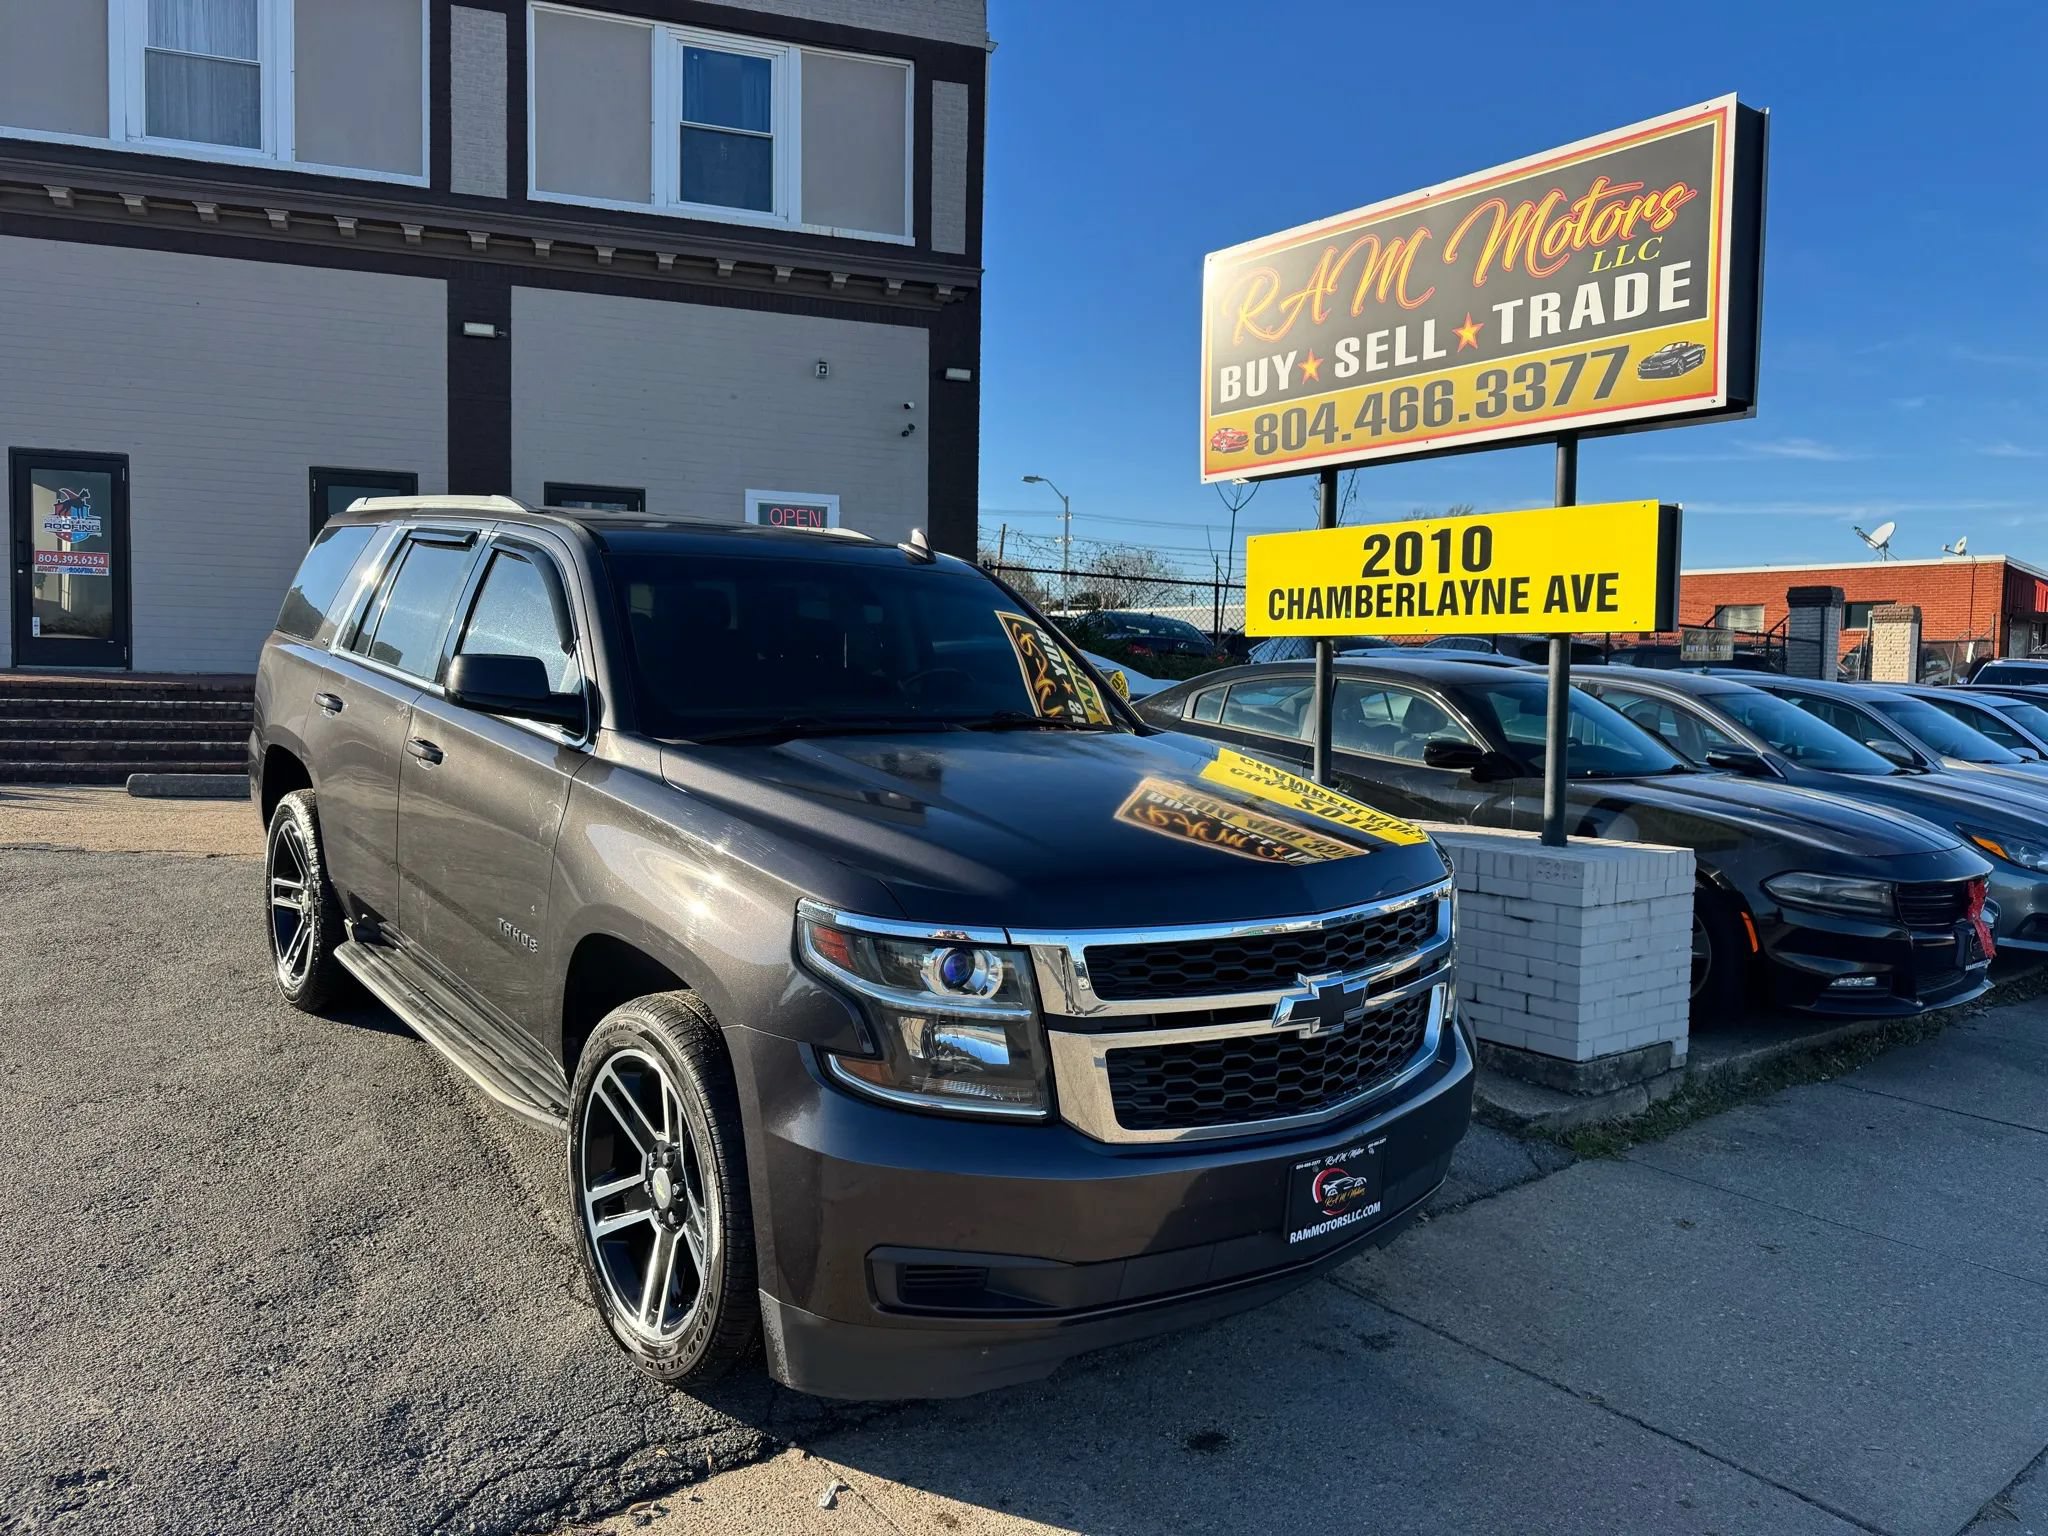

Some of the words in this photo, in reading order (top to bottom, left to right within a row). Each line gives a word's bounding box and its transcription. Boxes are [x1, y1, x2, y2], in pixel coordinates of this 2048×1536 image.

[1221, 226, 1436, 345] RAM
[1443, 176, 1698, 287] Motors
[1588, 235, 1663, 274] LLC
[1220, 350, 1297, 403] BUY
[1334, 318, 1447, 378] SELL
[1492, 260, 1692, 345] TRADE
[1254, 344, 1630, 456] 804.466.3377
[44, 522, 100, 531] ROOFING
[769, 508, 822, 528] OPEN
[38, 553, 105, 565] 804.395.6254
[1361, 525, 1493, 578] 2010
[1268, 577, 1531, 621] CHAMBERLAYNE
[1543, 572, 1619, 614] AVE
[497, 917, 538, 954] TAHOE
[1289, 1201, 1381, 1244] RAMMOTORSLLC.COM
